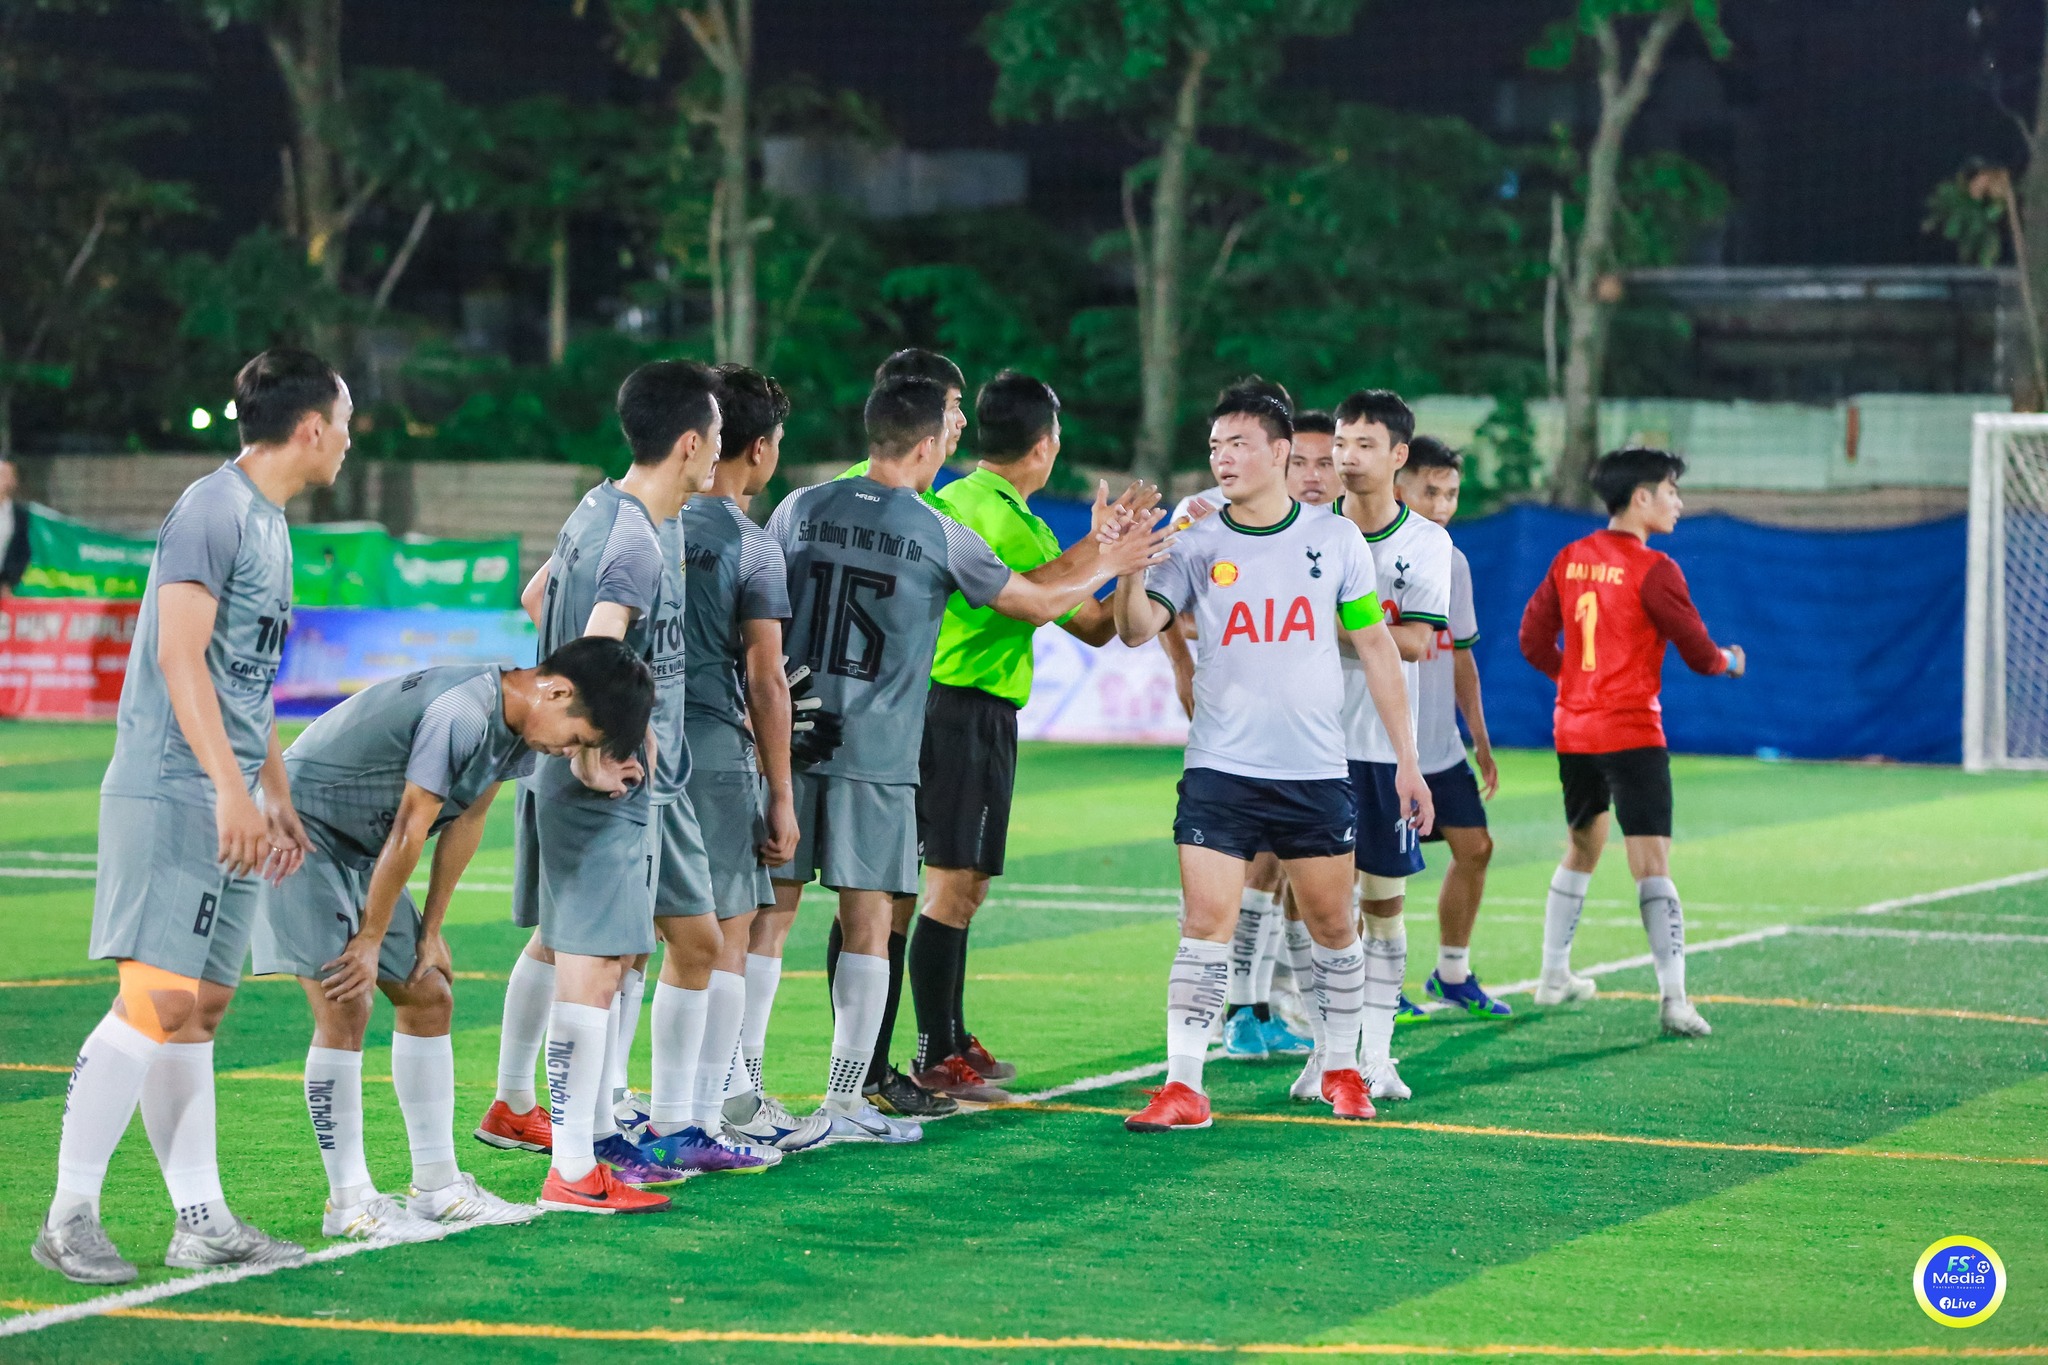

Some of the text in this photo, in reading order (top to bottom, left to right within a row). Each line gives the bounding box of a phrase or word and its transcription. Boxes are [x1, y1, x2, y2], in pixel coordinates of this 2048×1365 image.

[852, 526, 875, 550] TNG
[906, 539, 923, 562] An
[807, 560, 897, 682] 16
[1221, 595, 1315, 647] AIA
[1574, 591, 1598, 672] 1
[193, 892, 217, 938] 8
[1184, 1008, 1215, 1029] FC
[549, 1041, 575, 1069] TNG
[308, 1079, 336, 1102] TNG
[317, 1133, 336, 1150] AN
